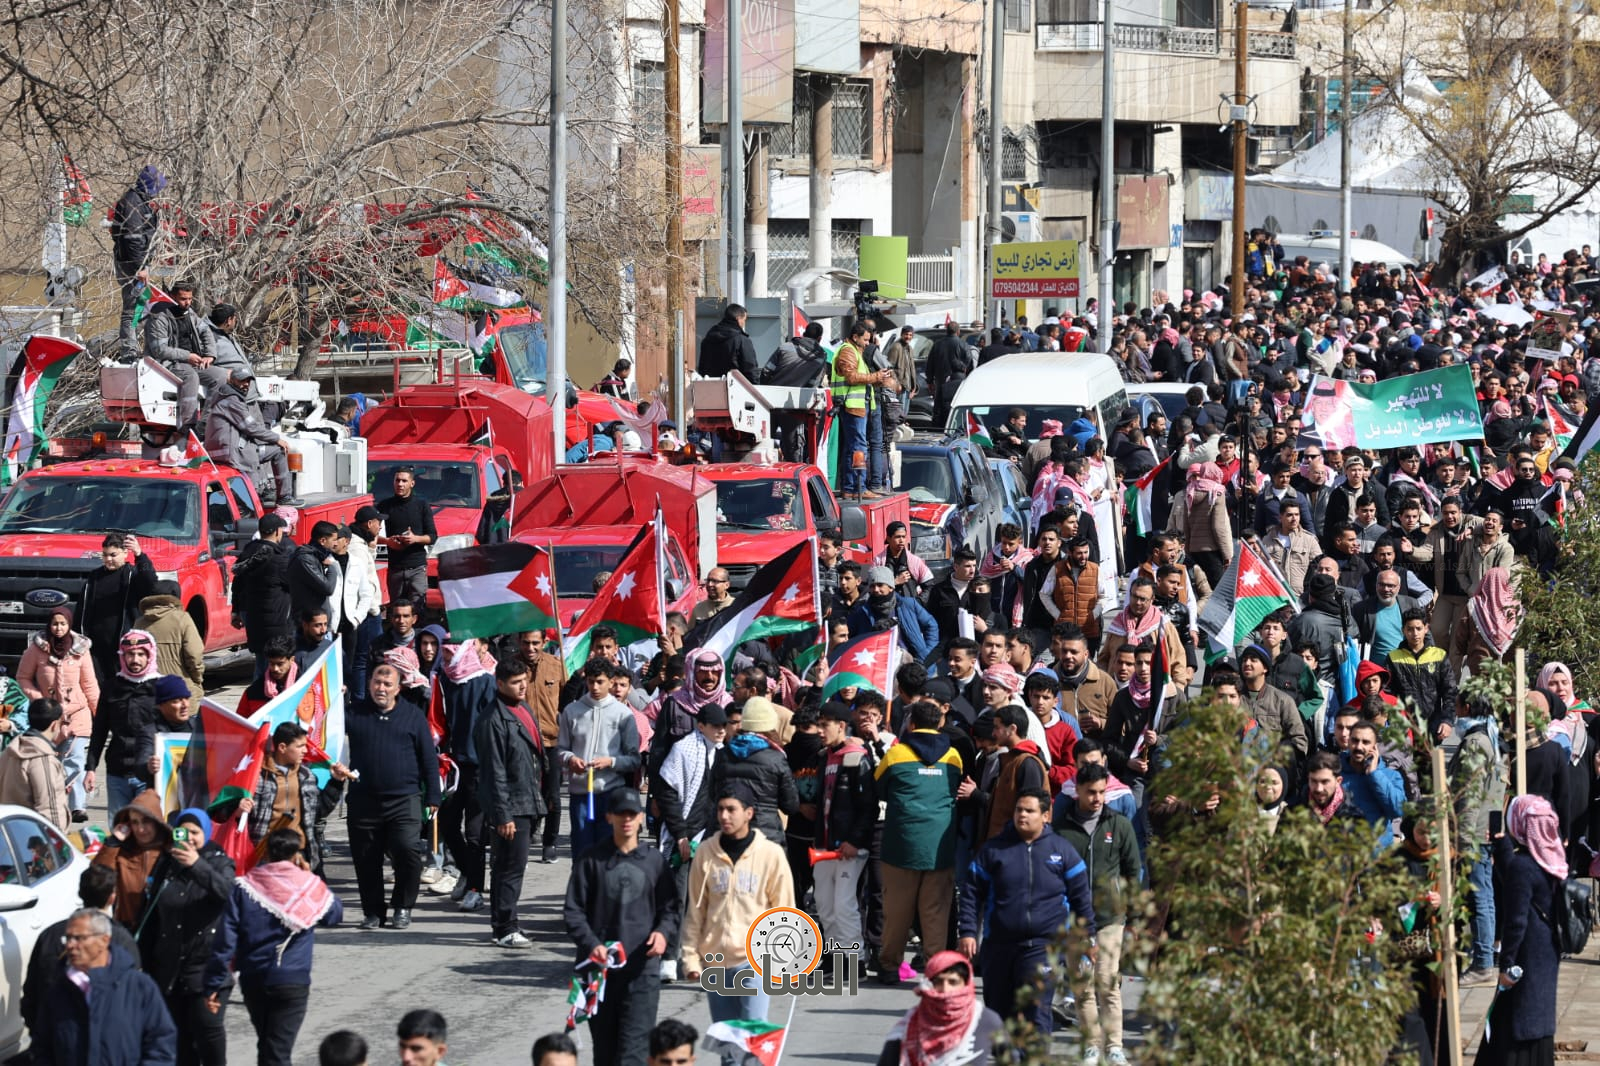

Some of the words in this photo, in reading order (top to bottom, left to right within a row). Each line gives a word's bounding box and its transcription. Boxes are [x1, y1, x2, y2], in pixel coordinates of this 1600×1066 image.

[996, 252, 1020, 274] للبيع
[1022, 251, 1052, 273] تجاري
[1054, 249, 1075, 271] أرض
[994, 281, 1039, 293] 0795042344
[1040, 282, 1057, 294] للعقار
[1385, 384, 1430, 413] للتهجير
[1431, 382, 1444, 400] لا
[1411, 412, 1451, 437] للوطن
[1453, 409, 1465, 425] لا
[1364, 421, 1408, 440] البديل
